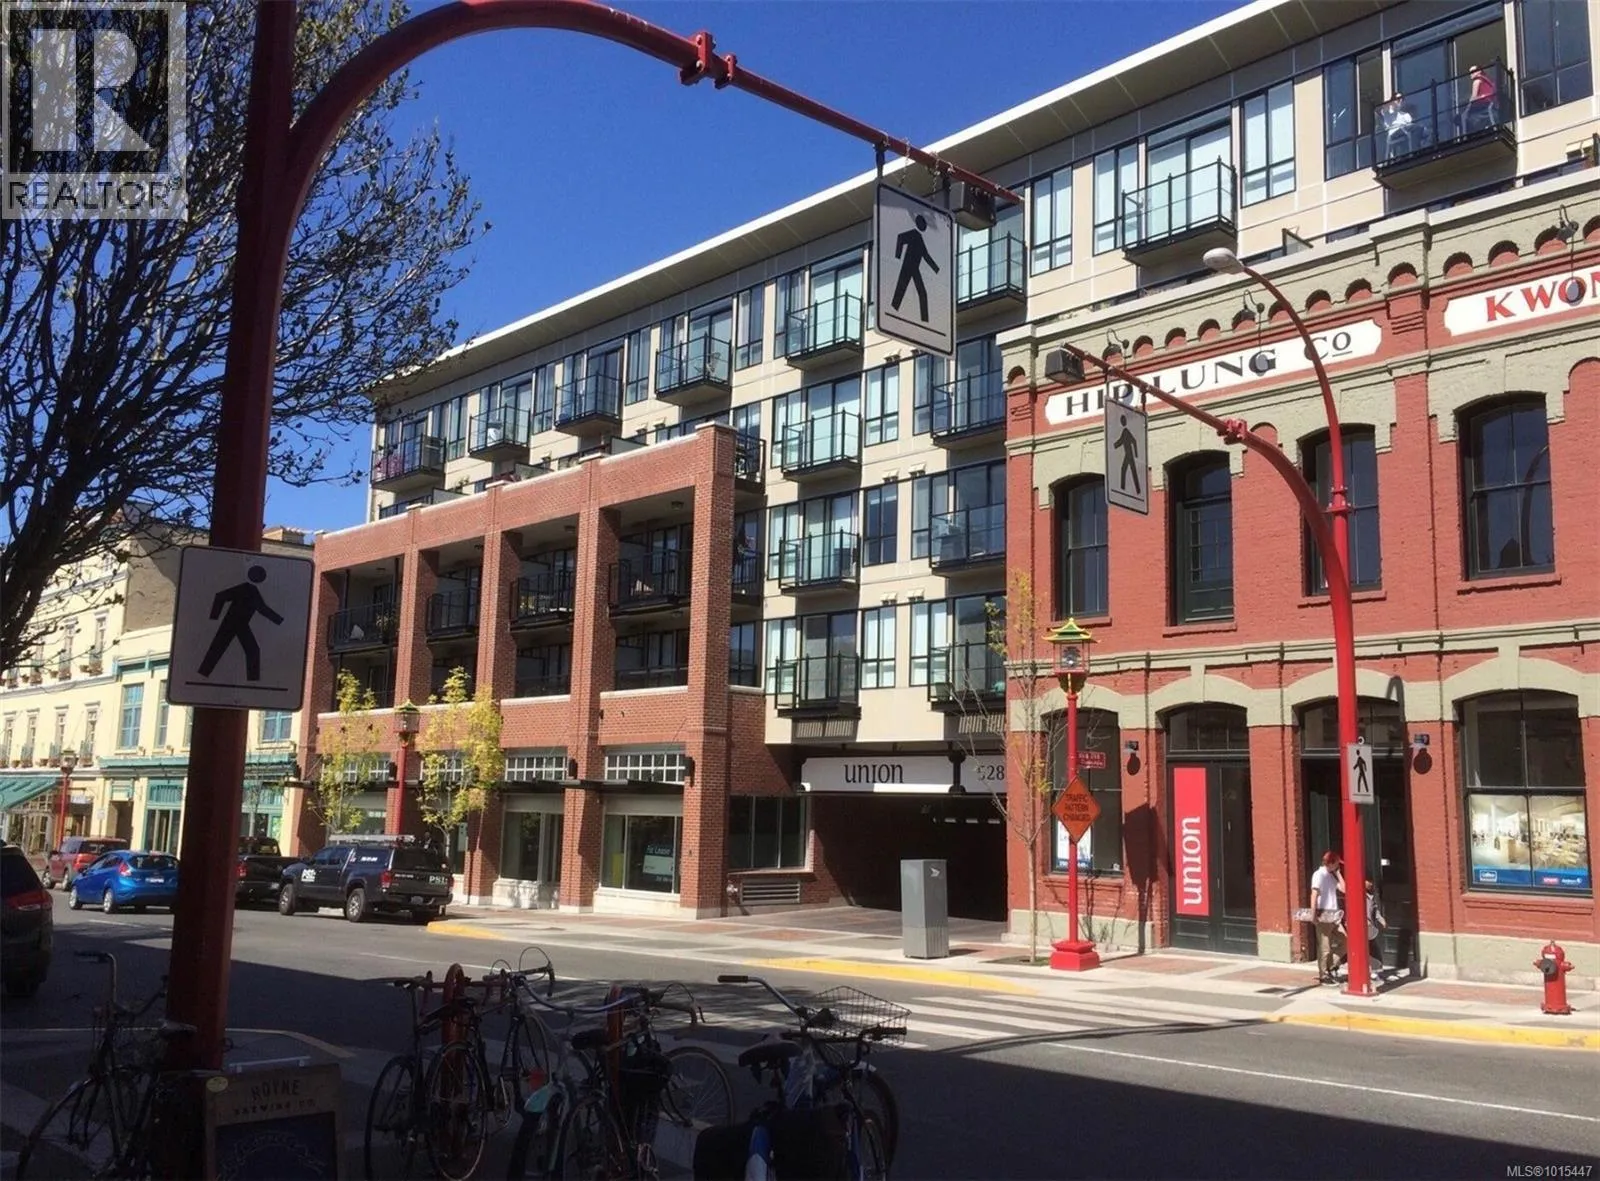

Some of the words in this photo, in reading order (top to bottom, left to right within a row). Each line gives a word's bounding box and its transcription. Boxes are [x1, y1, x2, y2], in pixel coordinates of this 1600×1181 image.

[1153, 348, 1276, 396] LUNG
[844, 763, 904, 784] union
[1065, 794, 1089, 803] TRAFFIC
[1064, 803, 1089, 812] PATTERN
[1063, 812, 1091, 822] CHANGED
[1181, 815, 1203, 906] union
